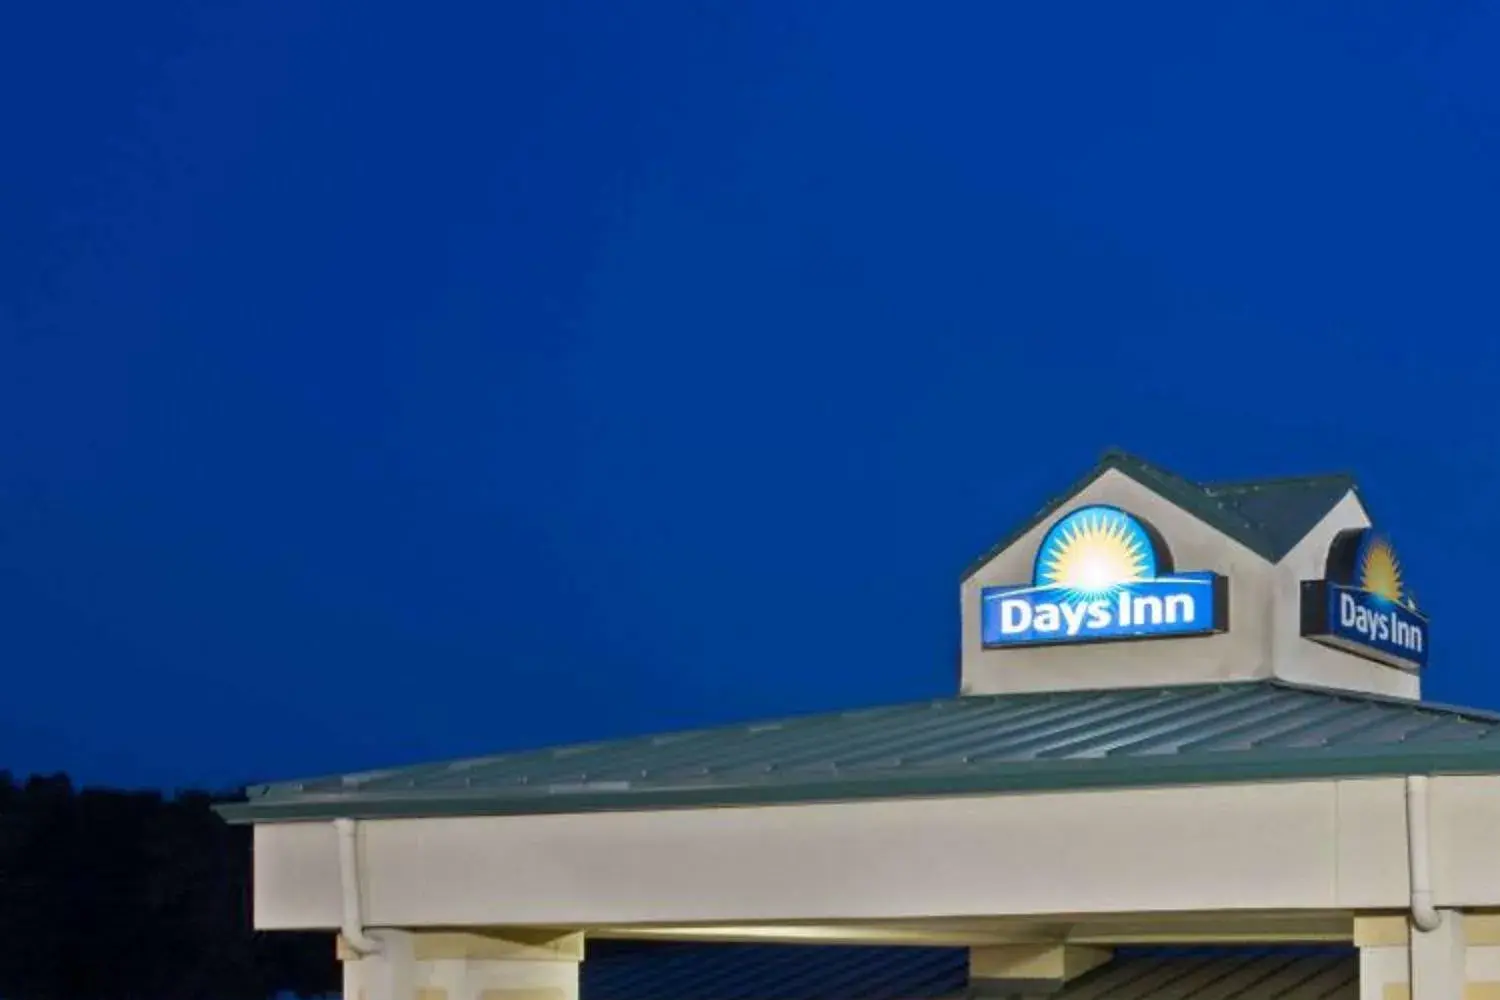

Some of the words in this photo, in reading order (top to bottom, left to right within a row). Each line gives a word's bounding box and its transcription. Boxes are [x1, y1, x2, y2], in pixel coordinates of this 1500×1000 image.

[1001, 598, 1112, 636] Days
[1119, 591, 1195, 627] Inn
[1340, 592, 1389, 641] Days
[1391, 611, 1422, 653] Inn
